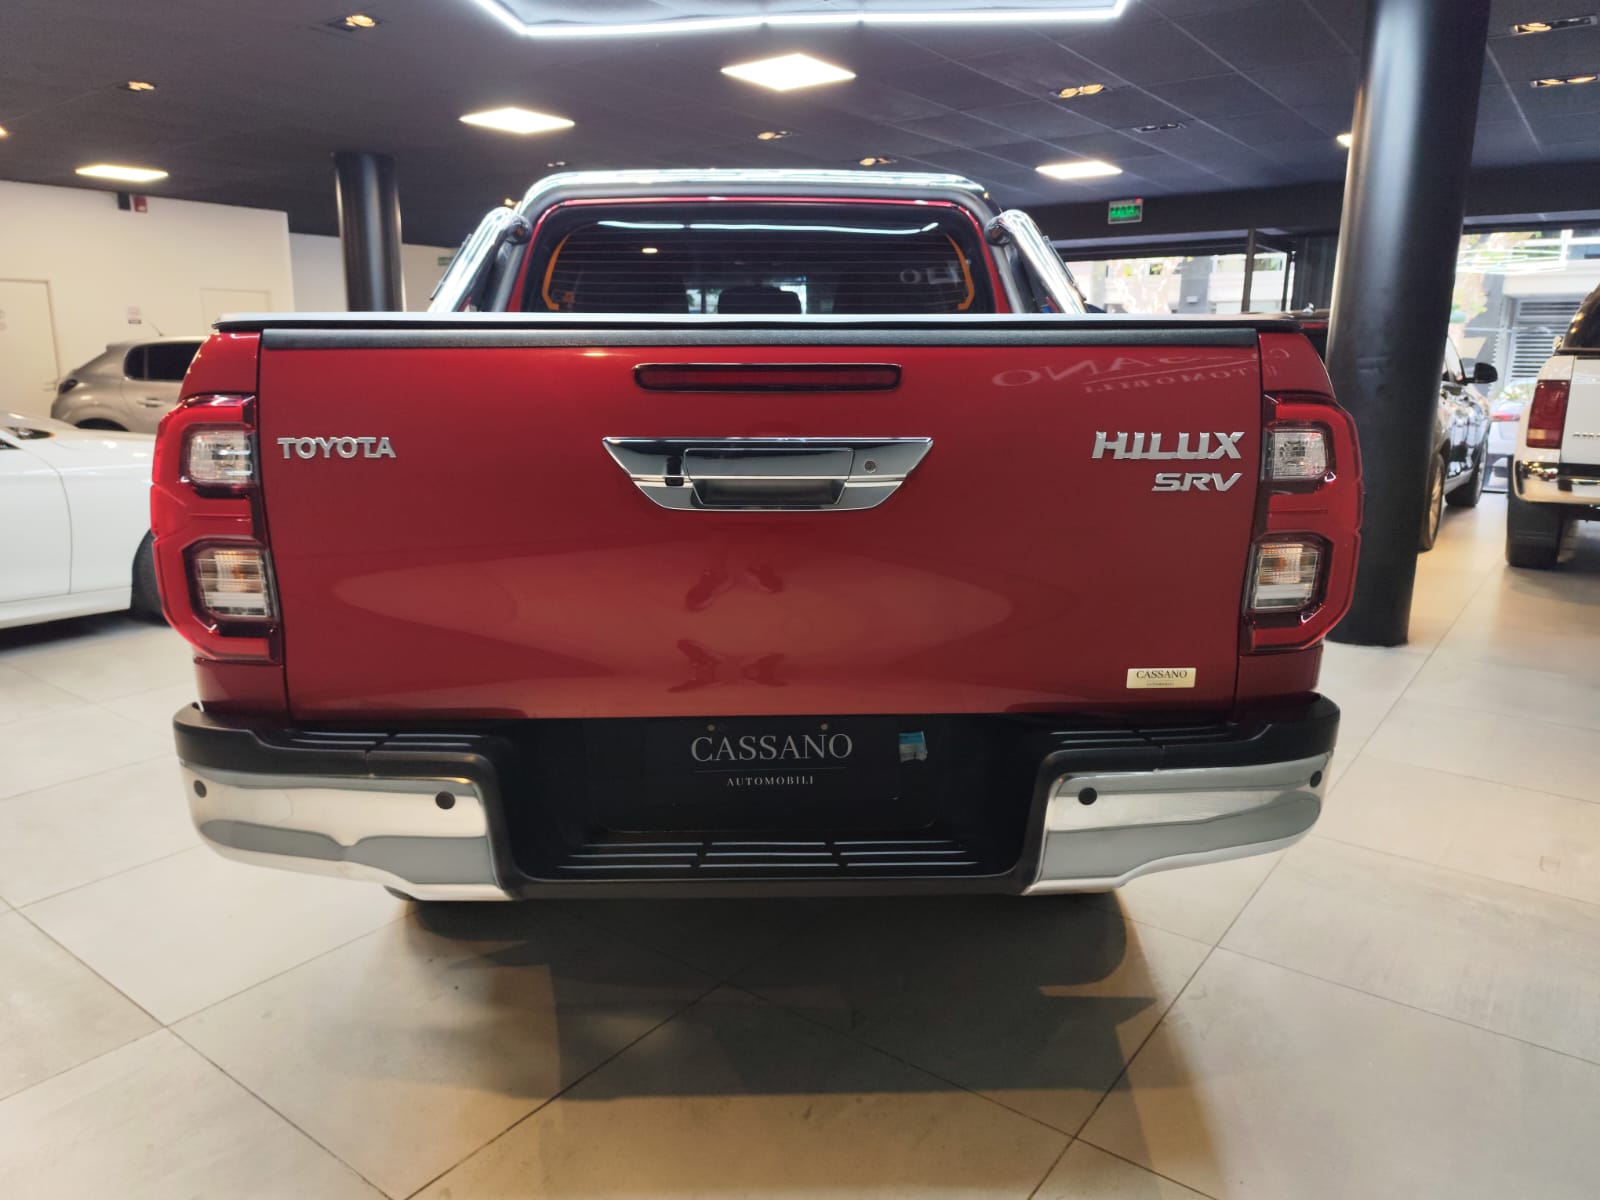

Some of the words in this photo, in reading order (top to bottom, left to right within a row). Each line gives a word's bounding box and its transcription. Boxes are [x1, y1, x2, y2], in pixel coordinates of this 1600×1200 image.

[277, 436, 397, 459] TOYOTA
[1091, 431, 1245, 460] HILUX
[1151, 472, 1243, 492] SRV
[1136, 670, 1188, 679] CASSANO
[691, 733, 853, 762] CASSANO
[726, 775, 815, 787] AUTOMOBILI
